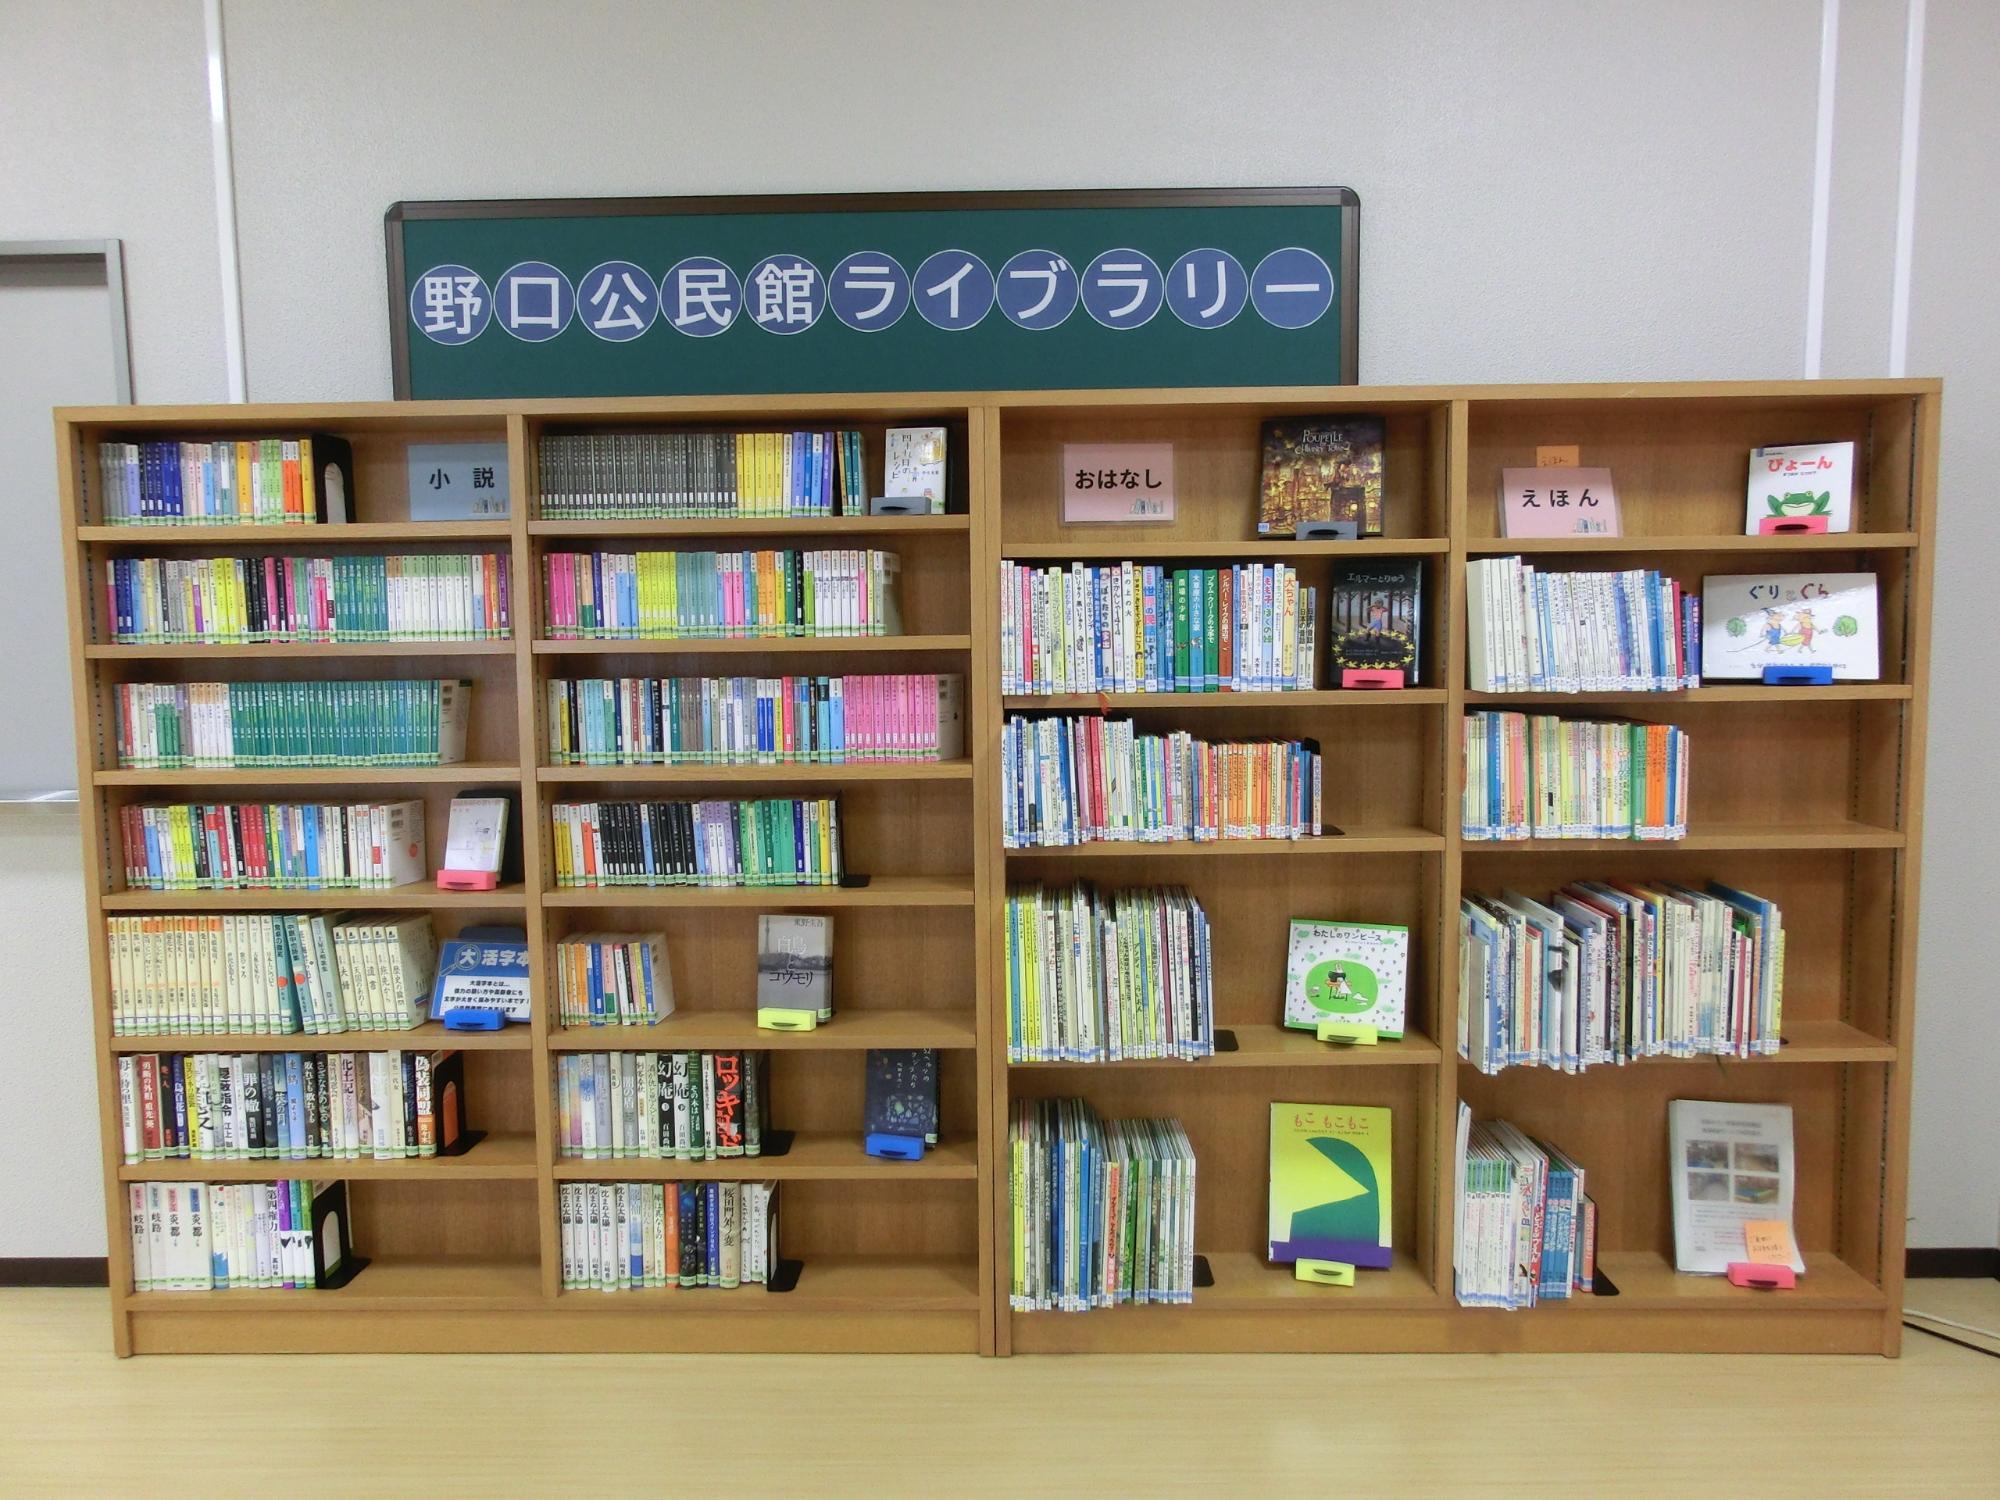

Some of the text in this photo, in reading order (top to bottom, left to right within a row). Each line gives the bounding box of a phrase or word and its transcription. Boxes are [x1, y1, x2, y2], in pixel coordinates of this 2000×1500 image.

[422, 259, 1321, 333] 野口公民館ライブラリー
[430, 467, 496, 490] 小説
[1075, 468, 1163, 490] おはなし
[1767, 456, 1833, 473] ぴょーん
[1522, 488, 1600, 508] えほん
[1124, 568, 1133, 618] 山の上の火
[1346, 571, 1407, 584] エルマーとりゅう
[1749, 582, 1830, 603] ぐりとぐら
[1178, 579, 1186, 622] 農場の少年
[1192, 575, 1201, 632] 大草原の小さな家
[1285, 577, 1295, 618] 大ちゃん
[1313, 928, 1383, 944] わたしのワンピース
[460, 949, 529, 967] 大活字本
[243, 1072, 260, 1113] 罪の轍
[318, 1060, 331, 1122] さざなみのよる
[690, 1084, 700, 1115] その本は
[716, 1055, 742, 1147] ロッキード
[1295, 1112, 1369, 1130] もこ もこもこ
[266, 1189, 280, 1233] 第四権力
